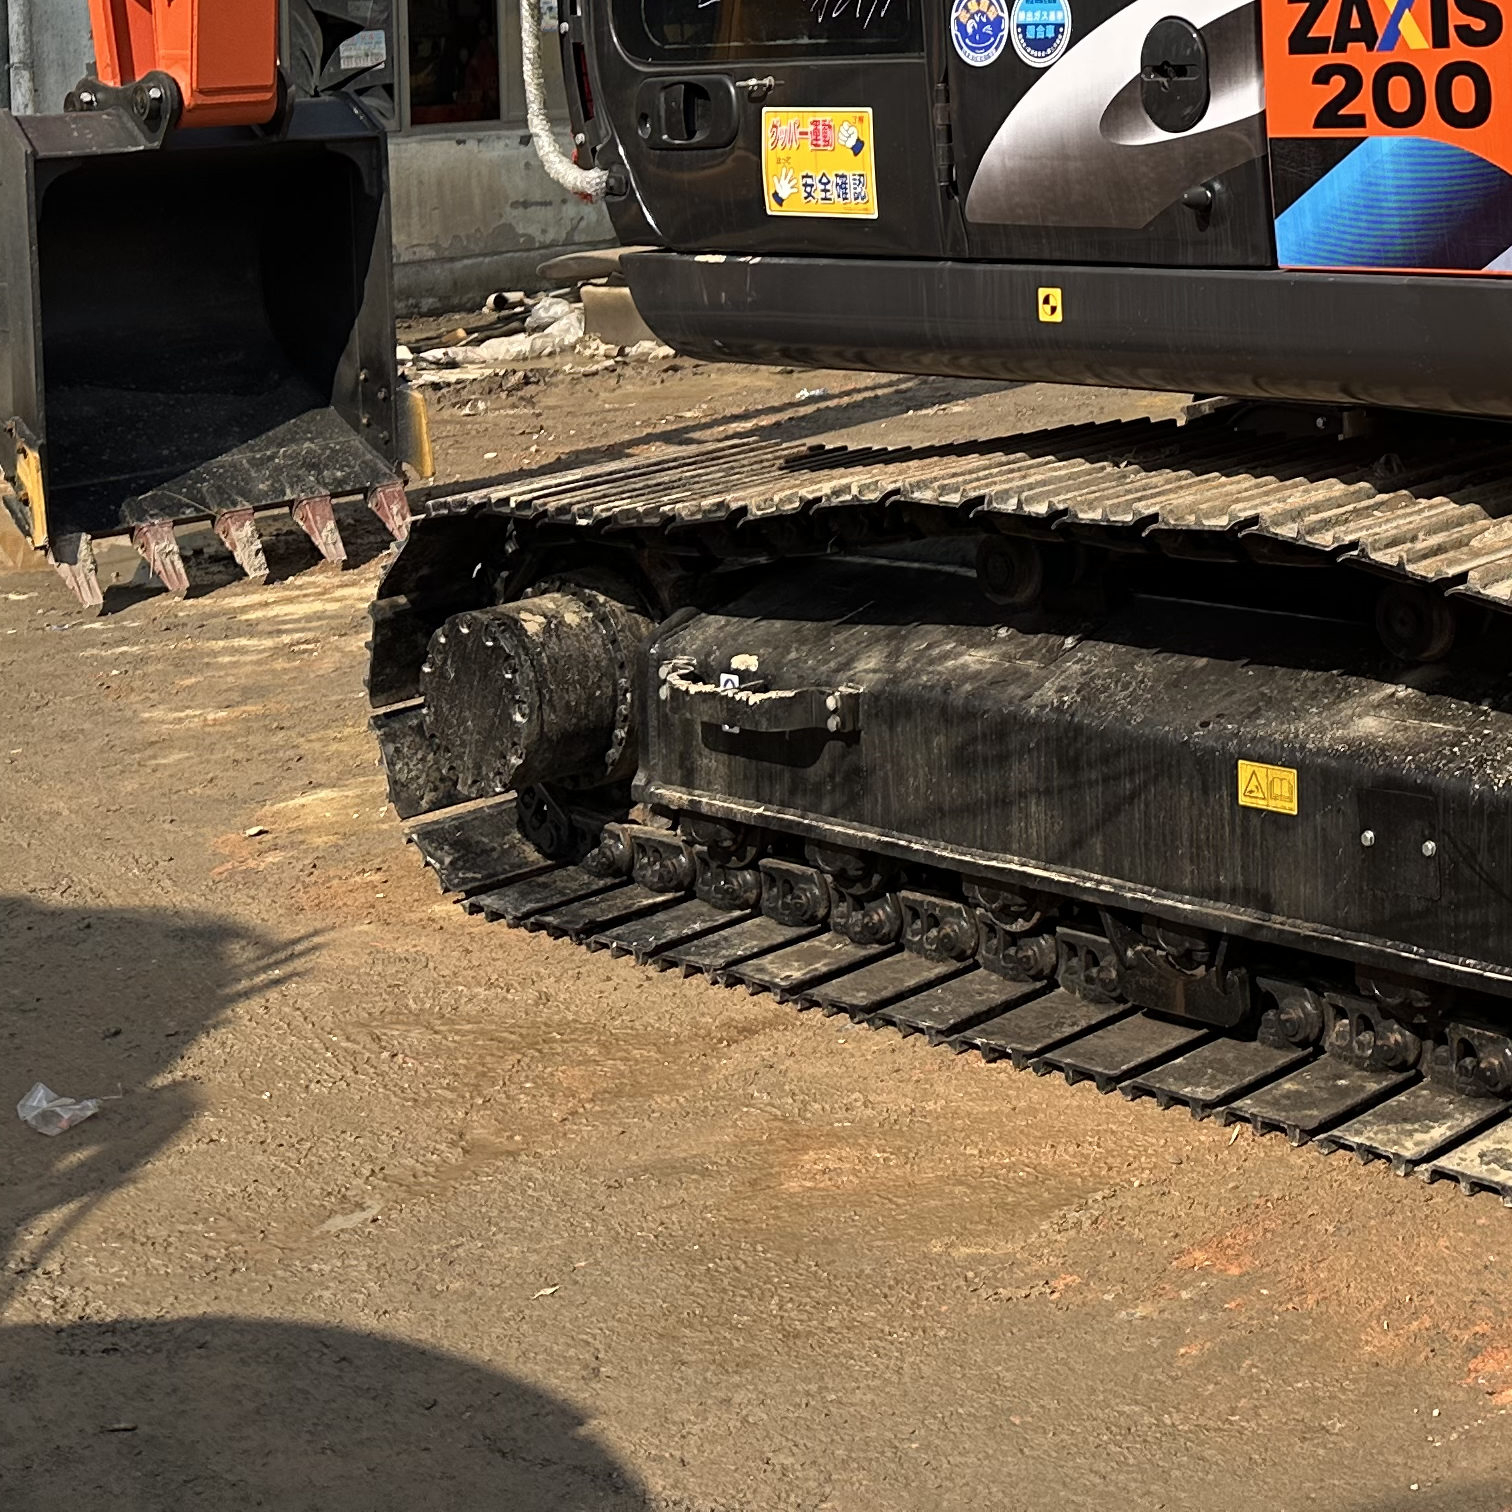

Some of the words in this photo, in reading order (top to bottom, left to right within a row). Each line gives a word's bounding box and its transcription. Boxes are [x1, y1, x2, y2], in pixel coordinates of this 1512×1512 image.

[1311, 59, 1492, 129] 200
[801, 171, 867, 201] 安全確認
